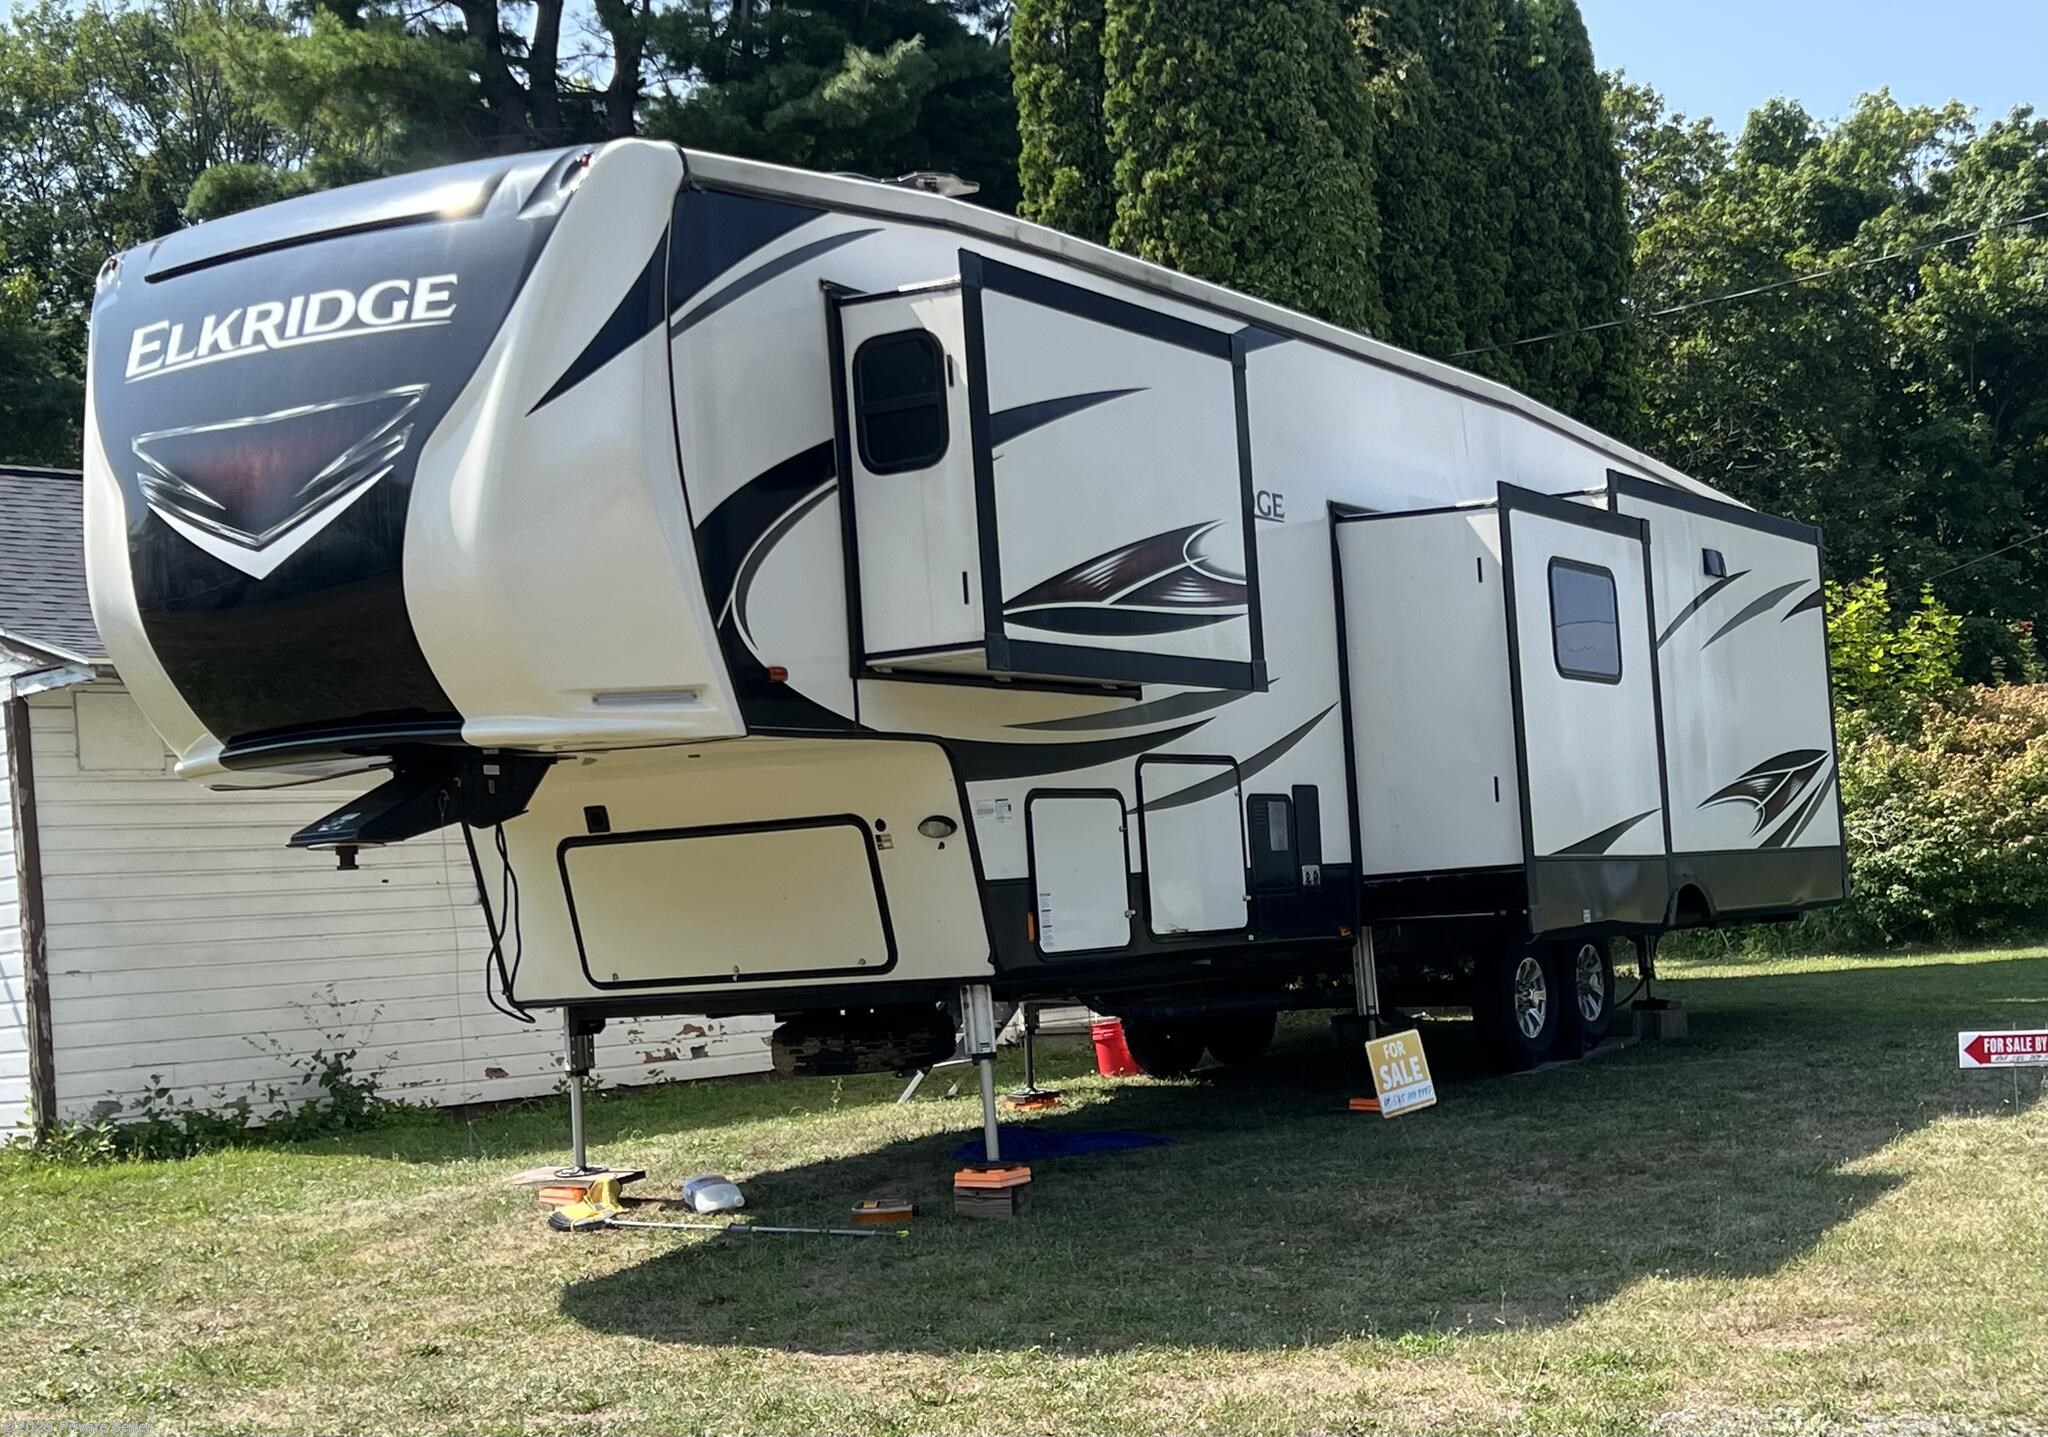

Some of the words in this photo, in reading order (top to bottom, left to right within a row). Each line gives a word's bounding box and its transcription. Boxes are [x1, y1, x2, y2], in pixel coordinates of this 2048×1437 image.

[124, 273, 458, 380] ELKRIDGE
[1383, 1041, 1407, 1060] FOR
[1983, 1037, 2005, 1054] FOR
[2006, 1036, 2033, 1053] SALE
[2034, 1036, 2048, 1052] BY
[1379, 1056, 1424, 1090] SALE
